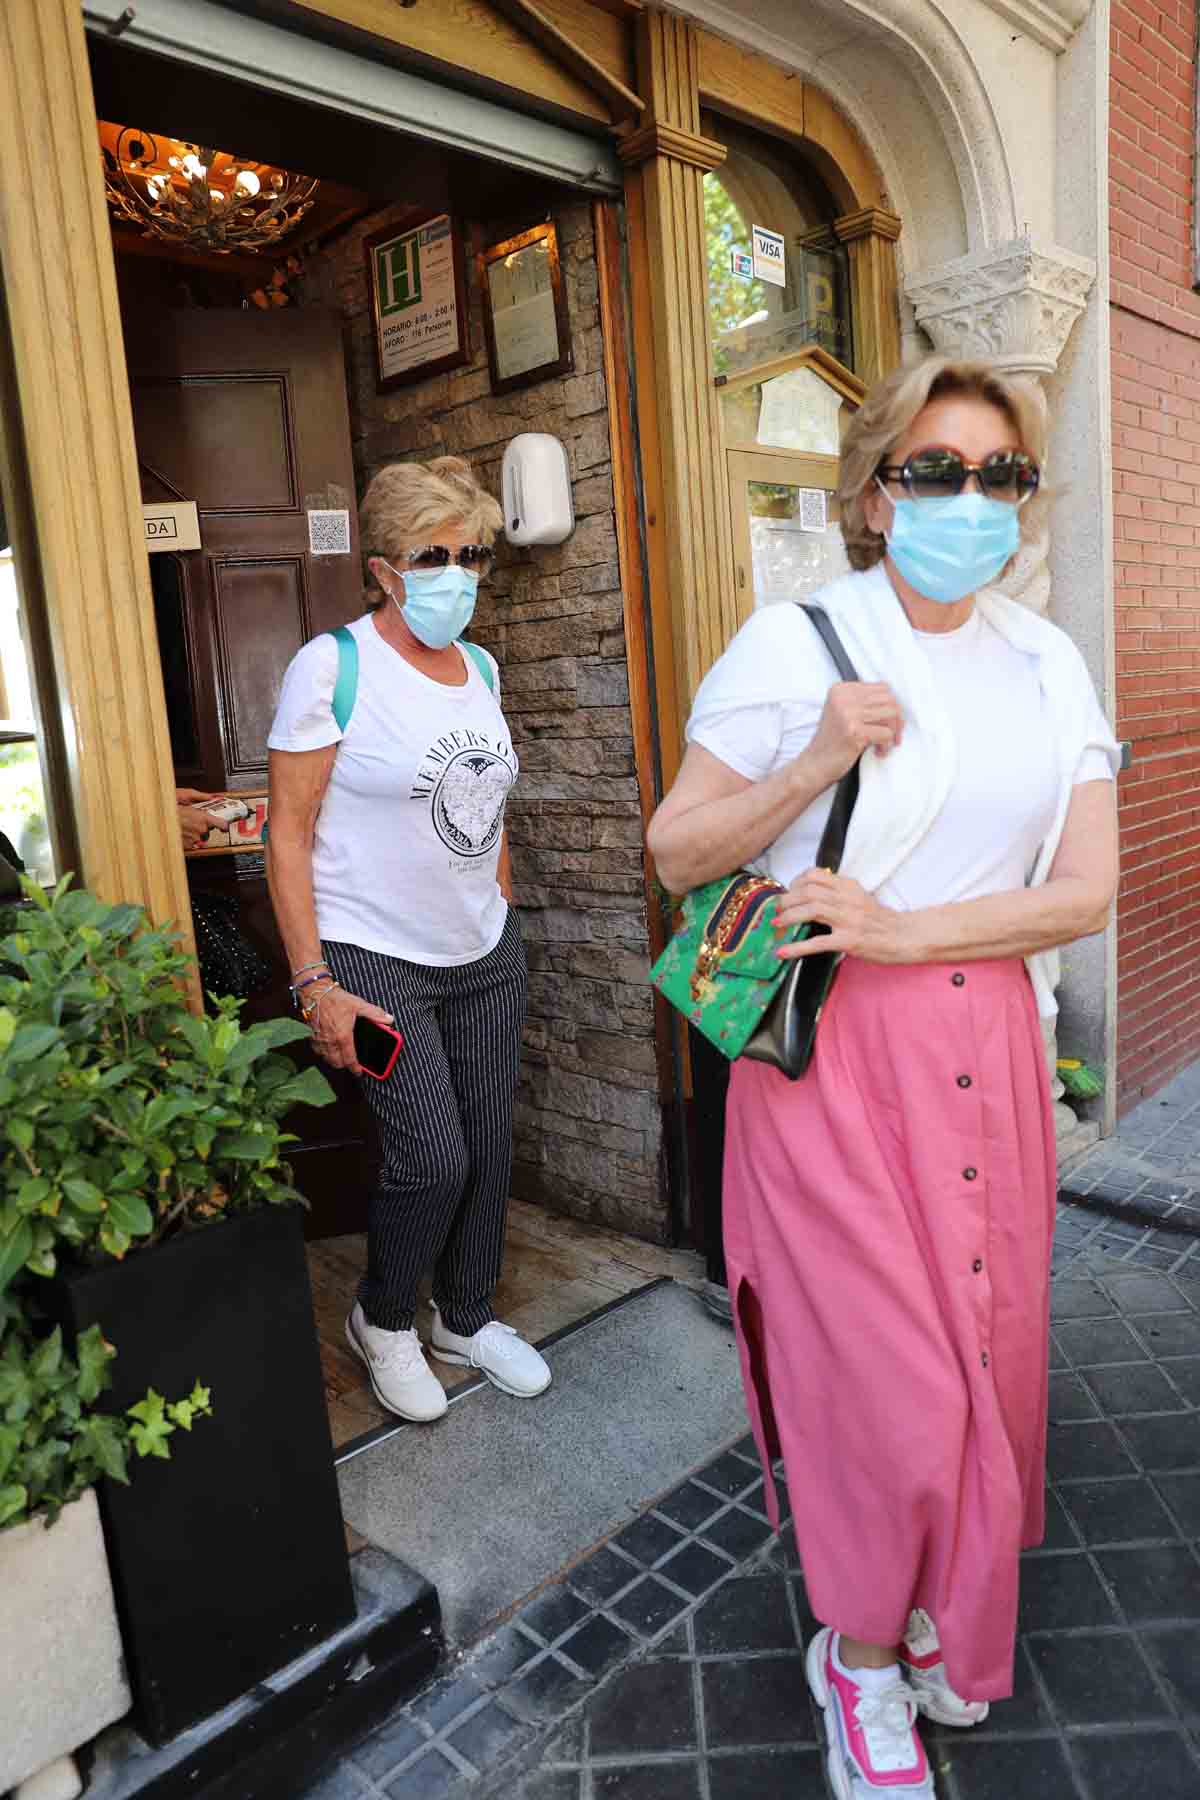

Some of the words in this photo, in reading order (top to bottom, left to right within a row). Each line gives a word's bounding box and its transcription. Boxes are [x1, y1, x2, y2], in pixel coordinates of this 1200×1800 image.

[381, 237, 419, 310] H
[759, 240, 780, 259] VISA
[409, 729, 490, 800] MEMBERS
